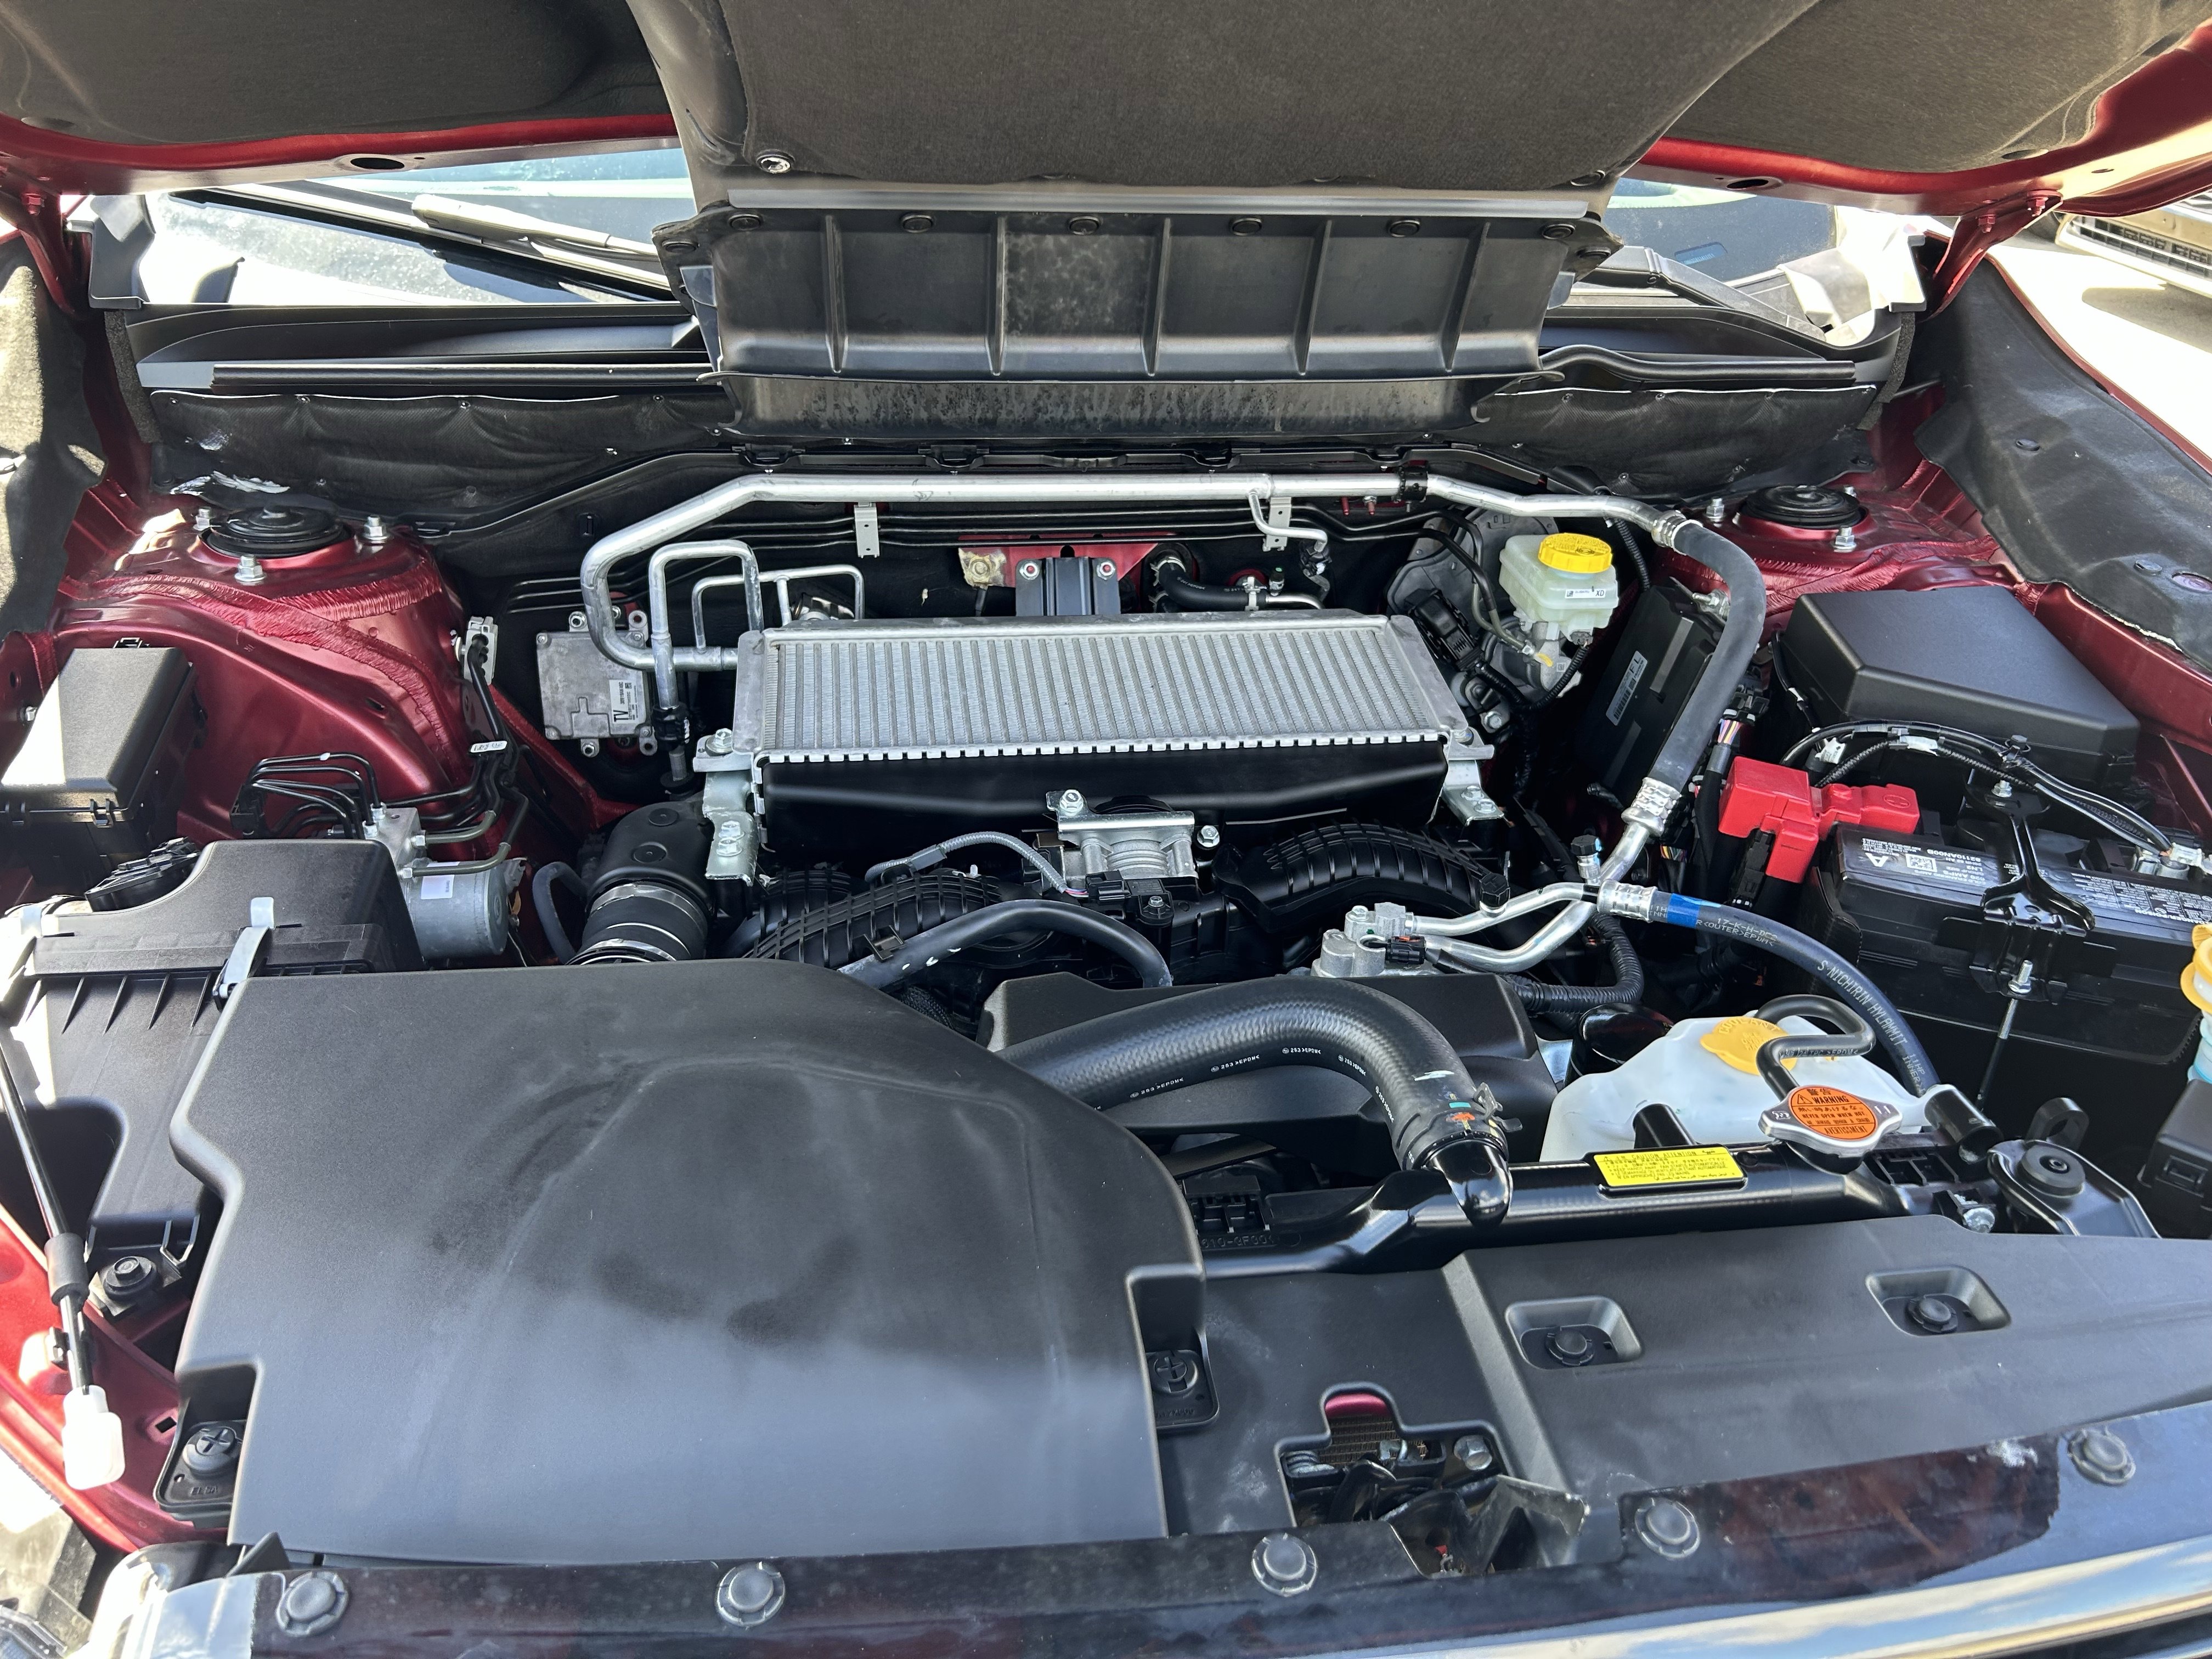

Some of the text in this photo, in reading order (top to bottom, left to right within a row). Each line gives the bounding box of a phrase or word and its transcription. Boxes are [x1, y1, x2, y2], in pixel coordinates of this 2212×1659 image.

[613, 710, 629, 722] TV
[1943, 870, 1968, 878] AMPS
[1718, 1017, 1781, 1034] COOLANT
[1812, 1095, 1850, 1104] WARNING
